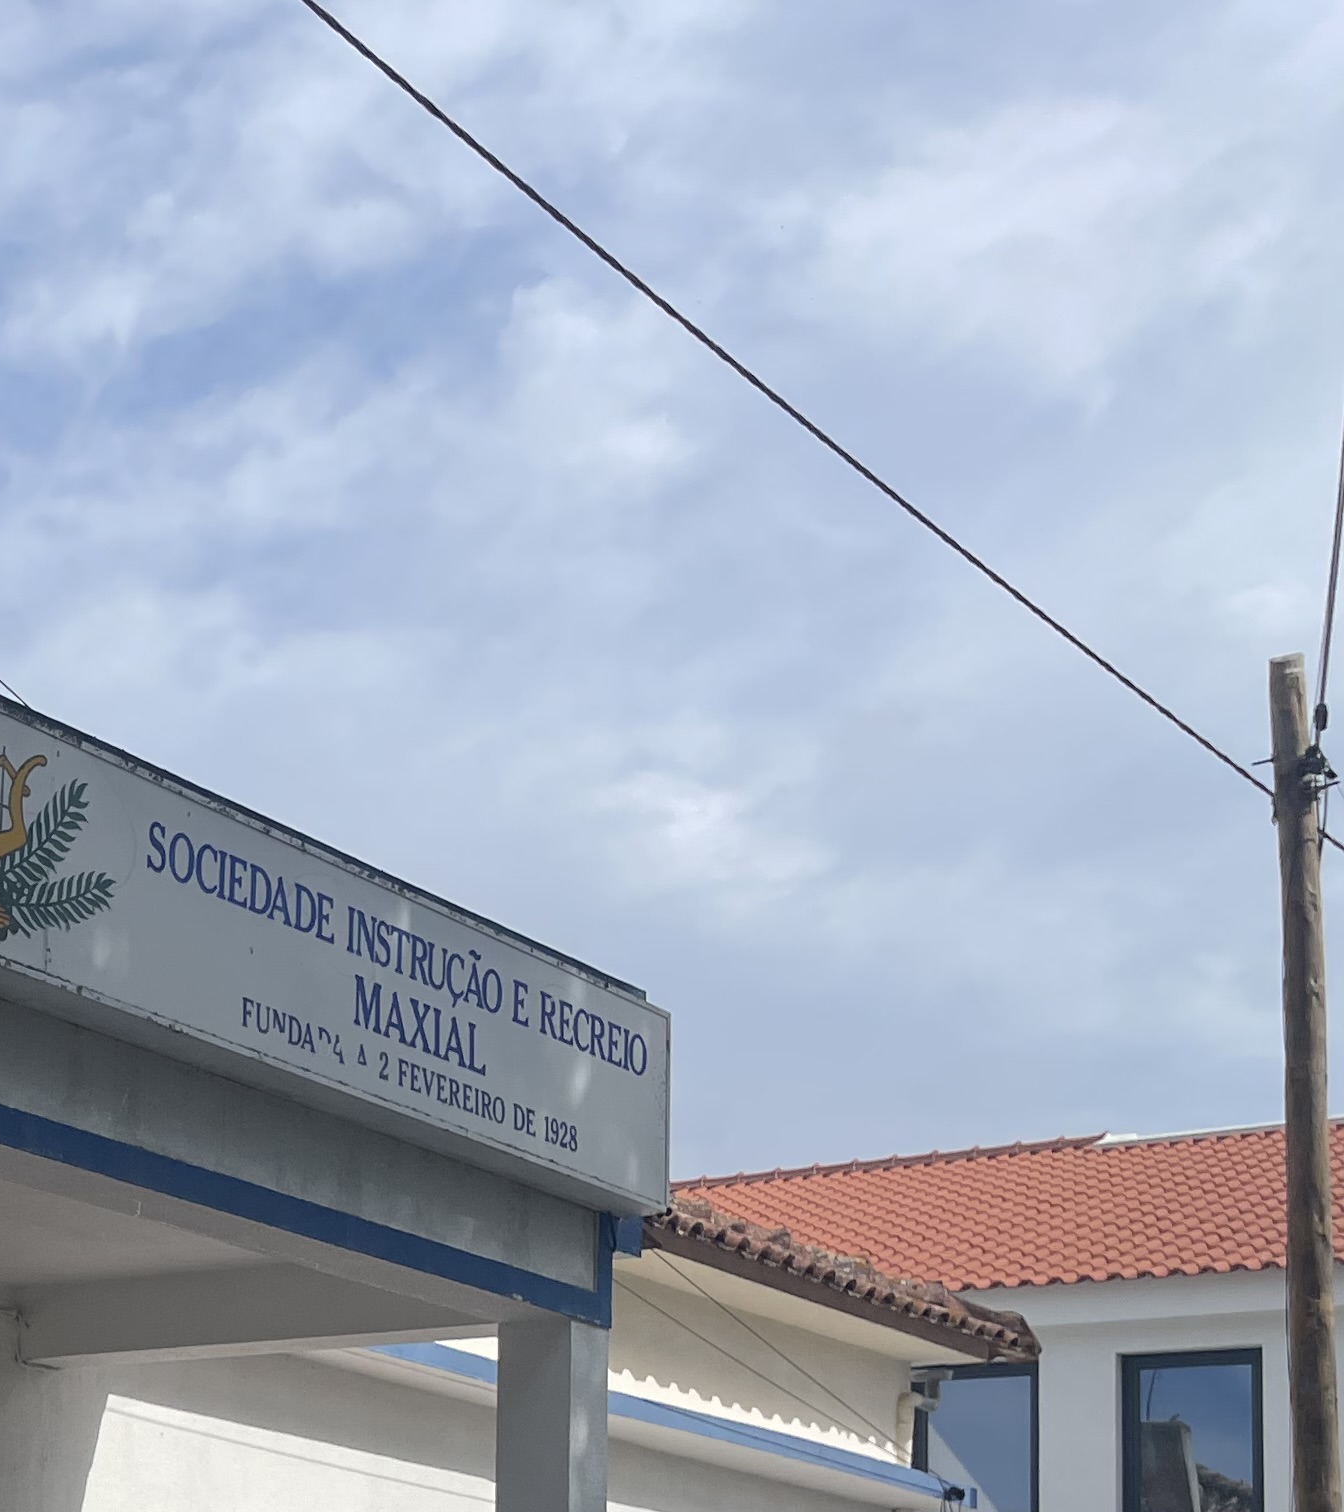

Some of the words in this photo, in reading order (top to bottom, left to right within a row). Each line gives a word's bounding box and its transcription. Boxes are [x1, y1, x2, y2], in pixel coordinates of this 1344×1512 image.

[146, 821, 335, 945] SOCIEDADE
[346, 905, 503, 1014] INSTRUÇÃO
[511, 979, 530, 1028] E
[539, 990, 648, 1076] RECREIO
[353, 974, 487, 1077] MAXIAL
[378, 1051, 390, 1082] 2
[397, 1057, 506, 1125] FEVEREIRO
[513, 1102, 537, 1137] DE
[544, 1115, 579, 1152] 1928
